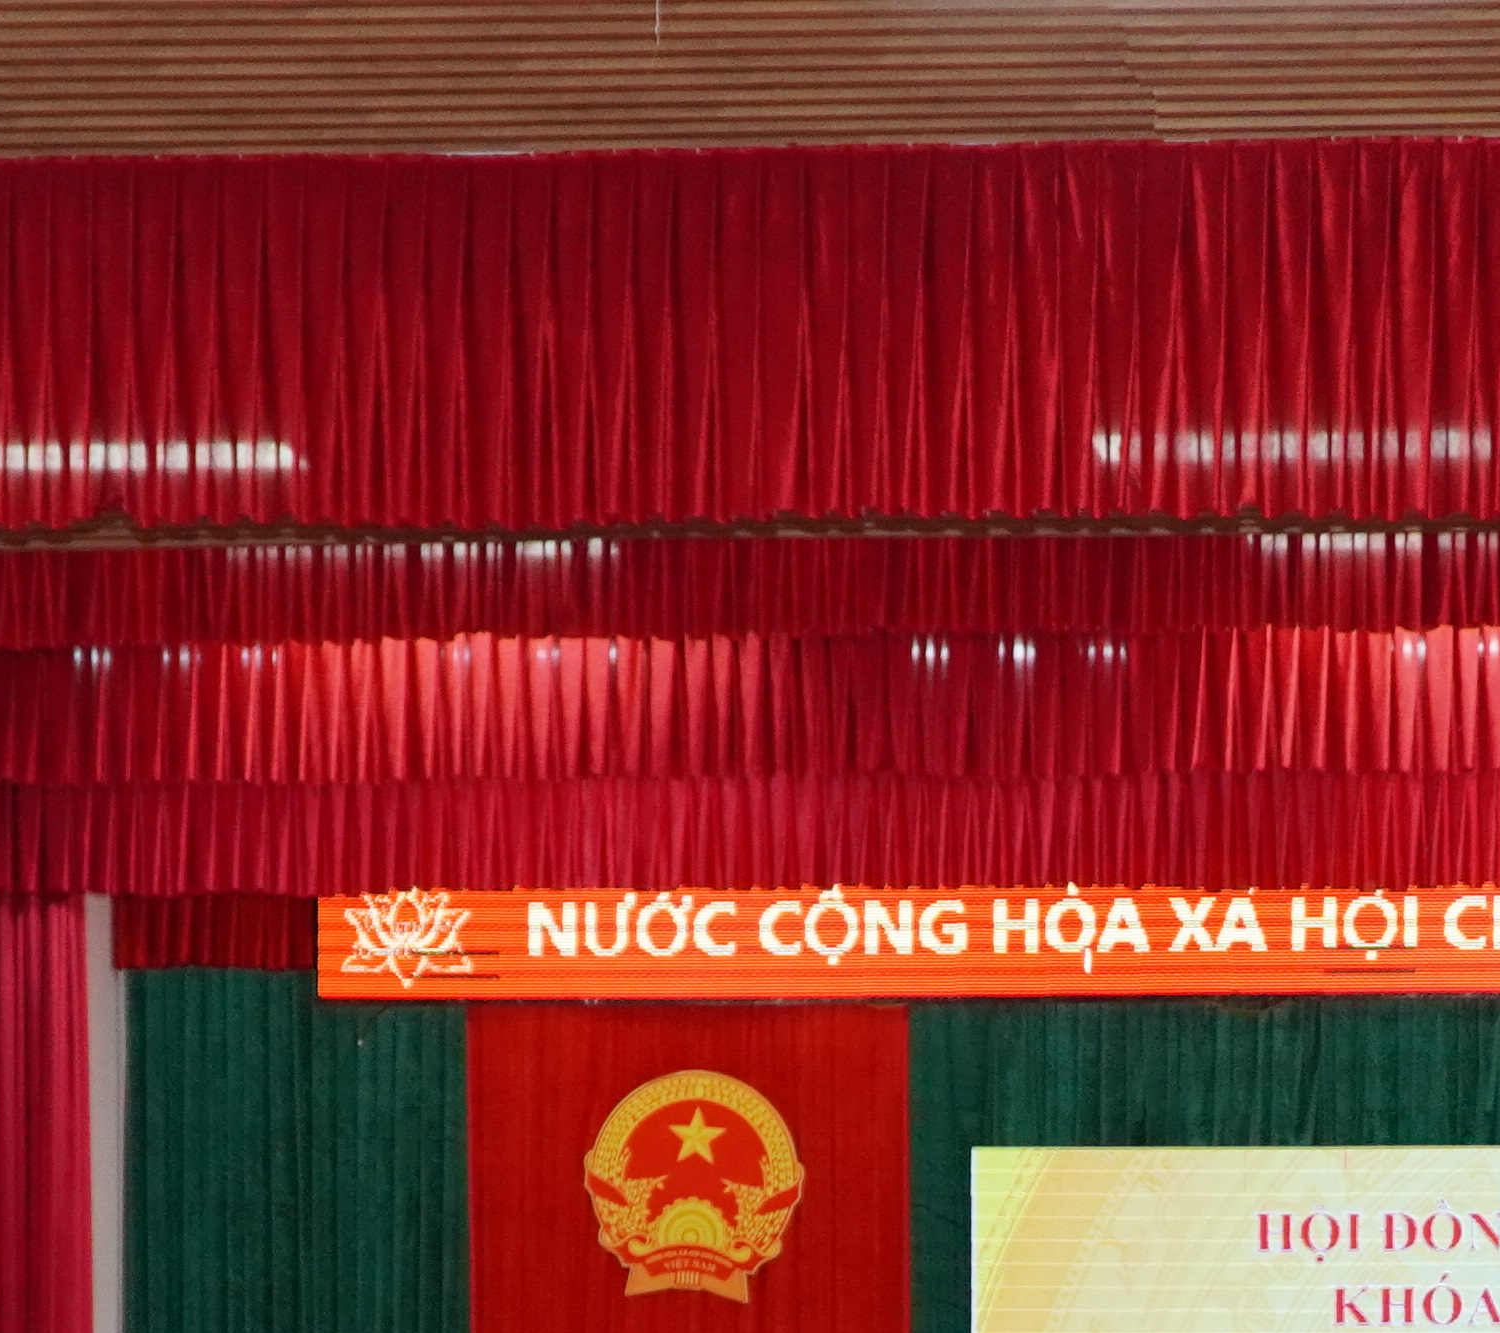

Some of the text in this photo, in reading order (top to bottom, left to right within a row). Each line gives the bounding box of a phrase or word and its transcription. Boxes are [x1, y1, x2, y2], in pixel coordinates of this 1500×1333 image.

[527, 892, 736, 956] NƯỚC
[758, 883, 968, 965] CỘNG
[1254, 1205, 1364, 1263] HỘI
